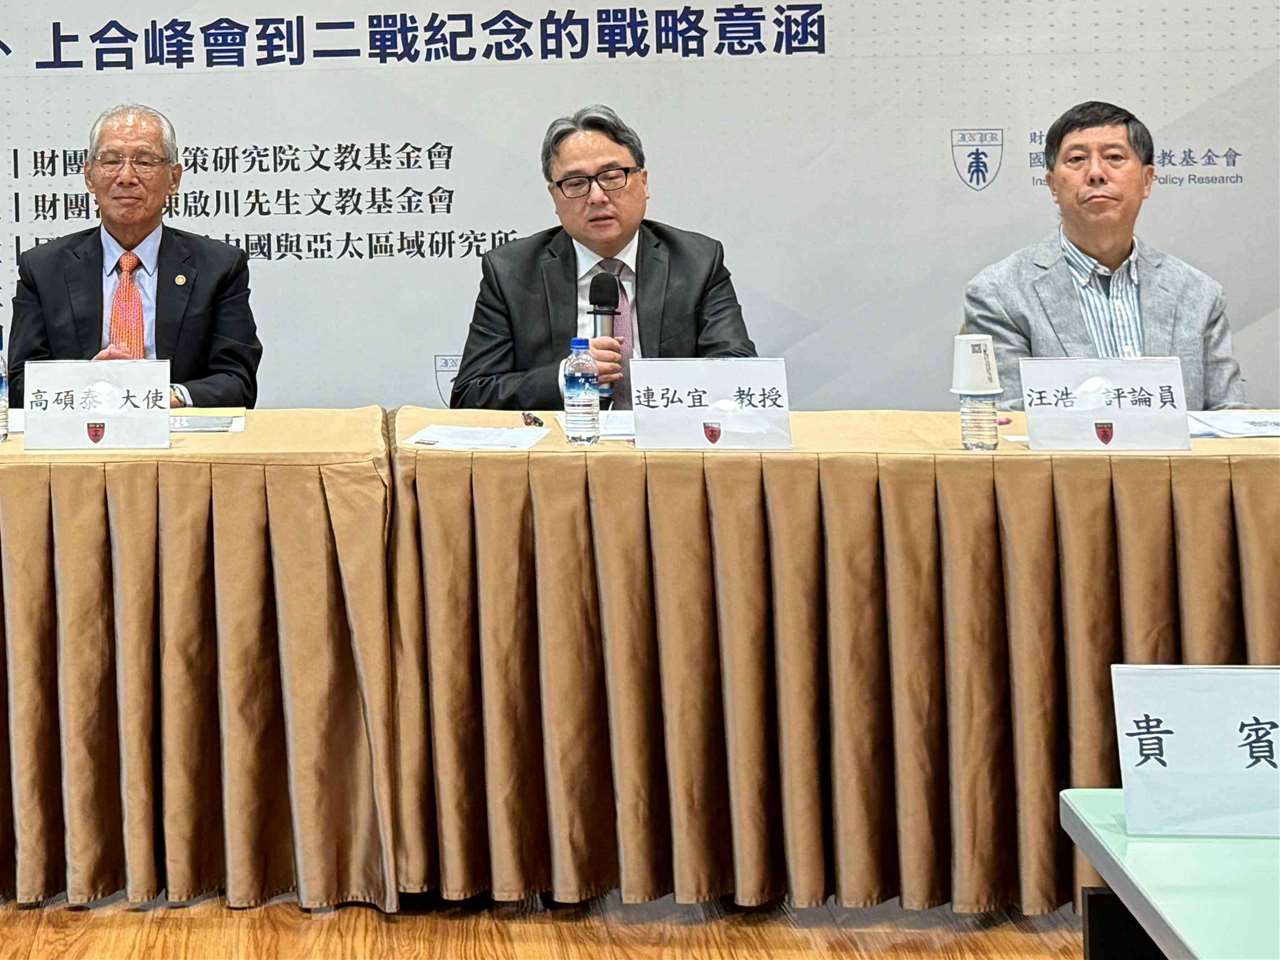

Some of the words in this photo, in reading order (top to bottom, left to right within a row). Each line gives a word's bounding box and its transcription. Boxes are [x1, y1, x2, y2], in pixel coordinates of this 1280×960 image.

[1188, 173, 1243, 184] Research
[30, 389, 102, 411] 高碩泰
[120, 389, 167, 410] 大使
[635, 386, 710, 409] 連弘宜
[733, 386, 784, 409] 教授
[1027, 387, 1076, 409] 汪浩
[1104, 385, 1177, 410] 評論員
